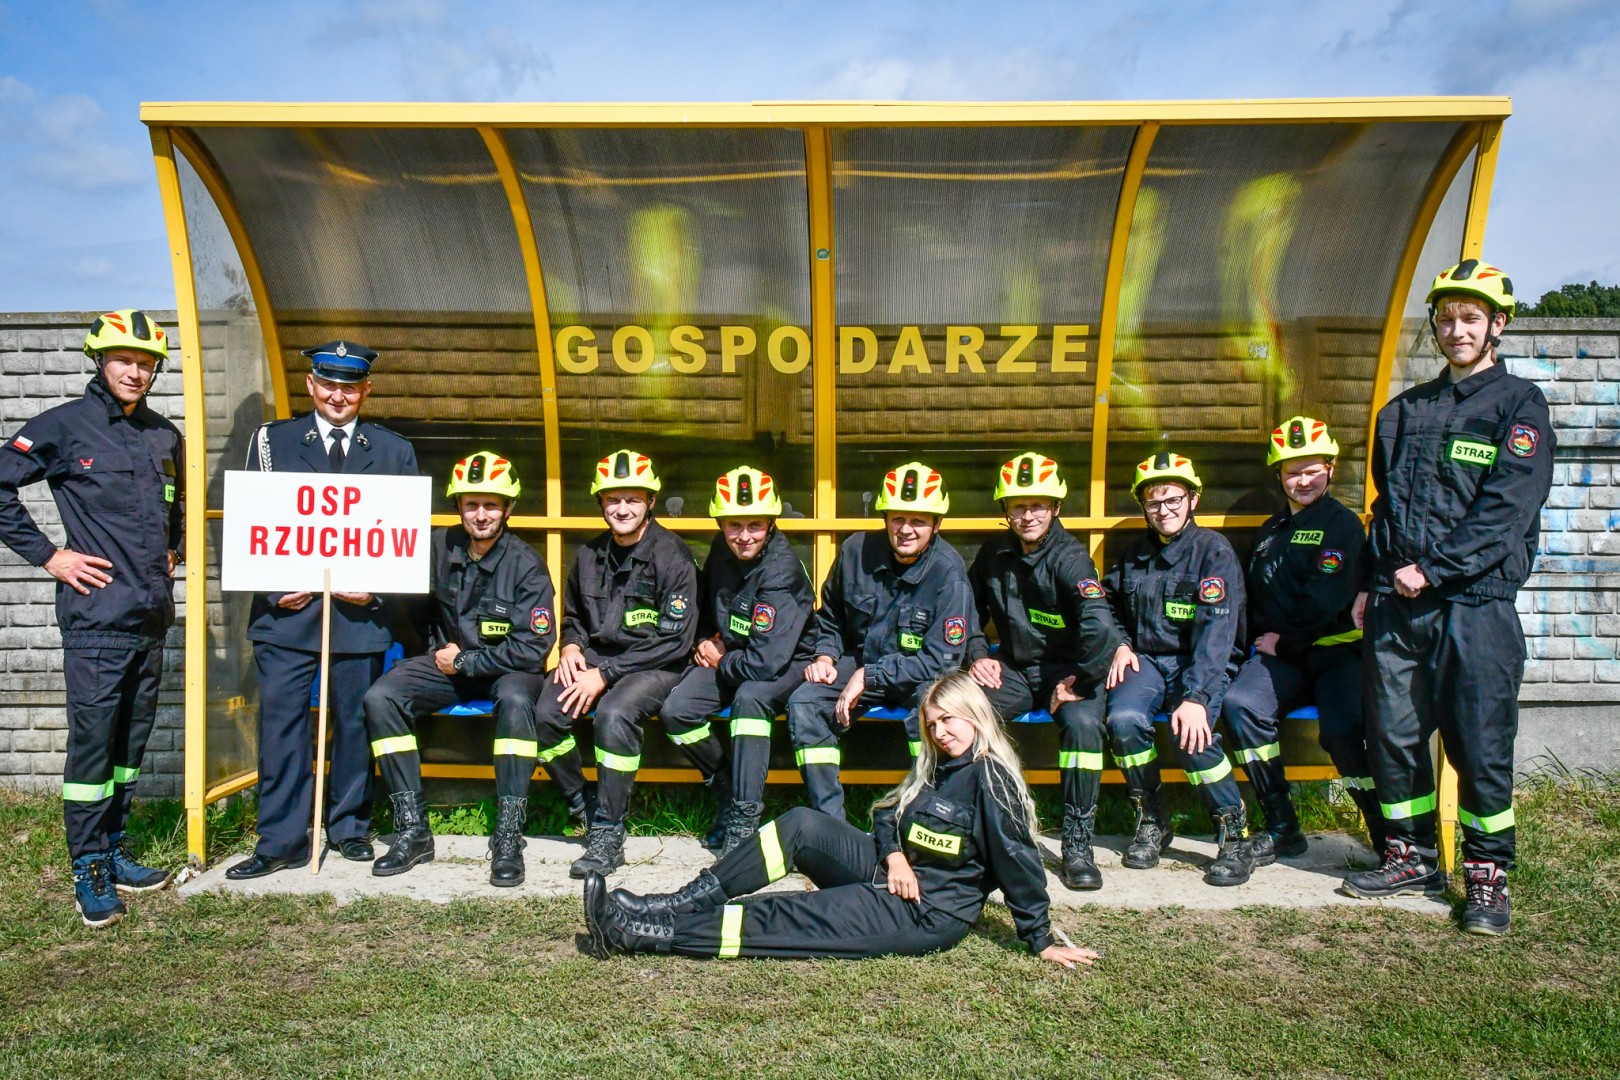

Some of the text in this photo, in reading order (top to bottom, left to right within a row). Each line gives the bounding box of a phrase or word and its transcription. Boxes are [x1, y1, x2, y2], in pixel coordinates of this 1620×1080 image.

[555, 324, 1089, 375] GOSPODARZE
[297, 485, 361, 516] OSP
[249, 518, 418, 558] RZUCHÓW
[1171, 606, 1196, 616] STRA
[488, 624, 512, 632] STRA
[731, 619, 750, 631] STRA
